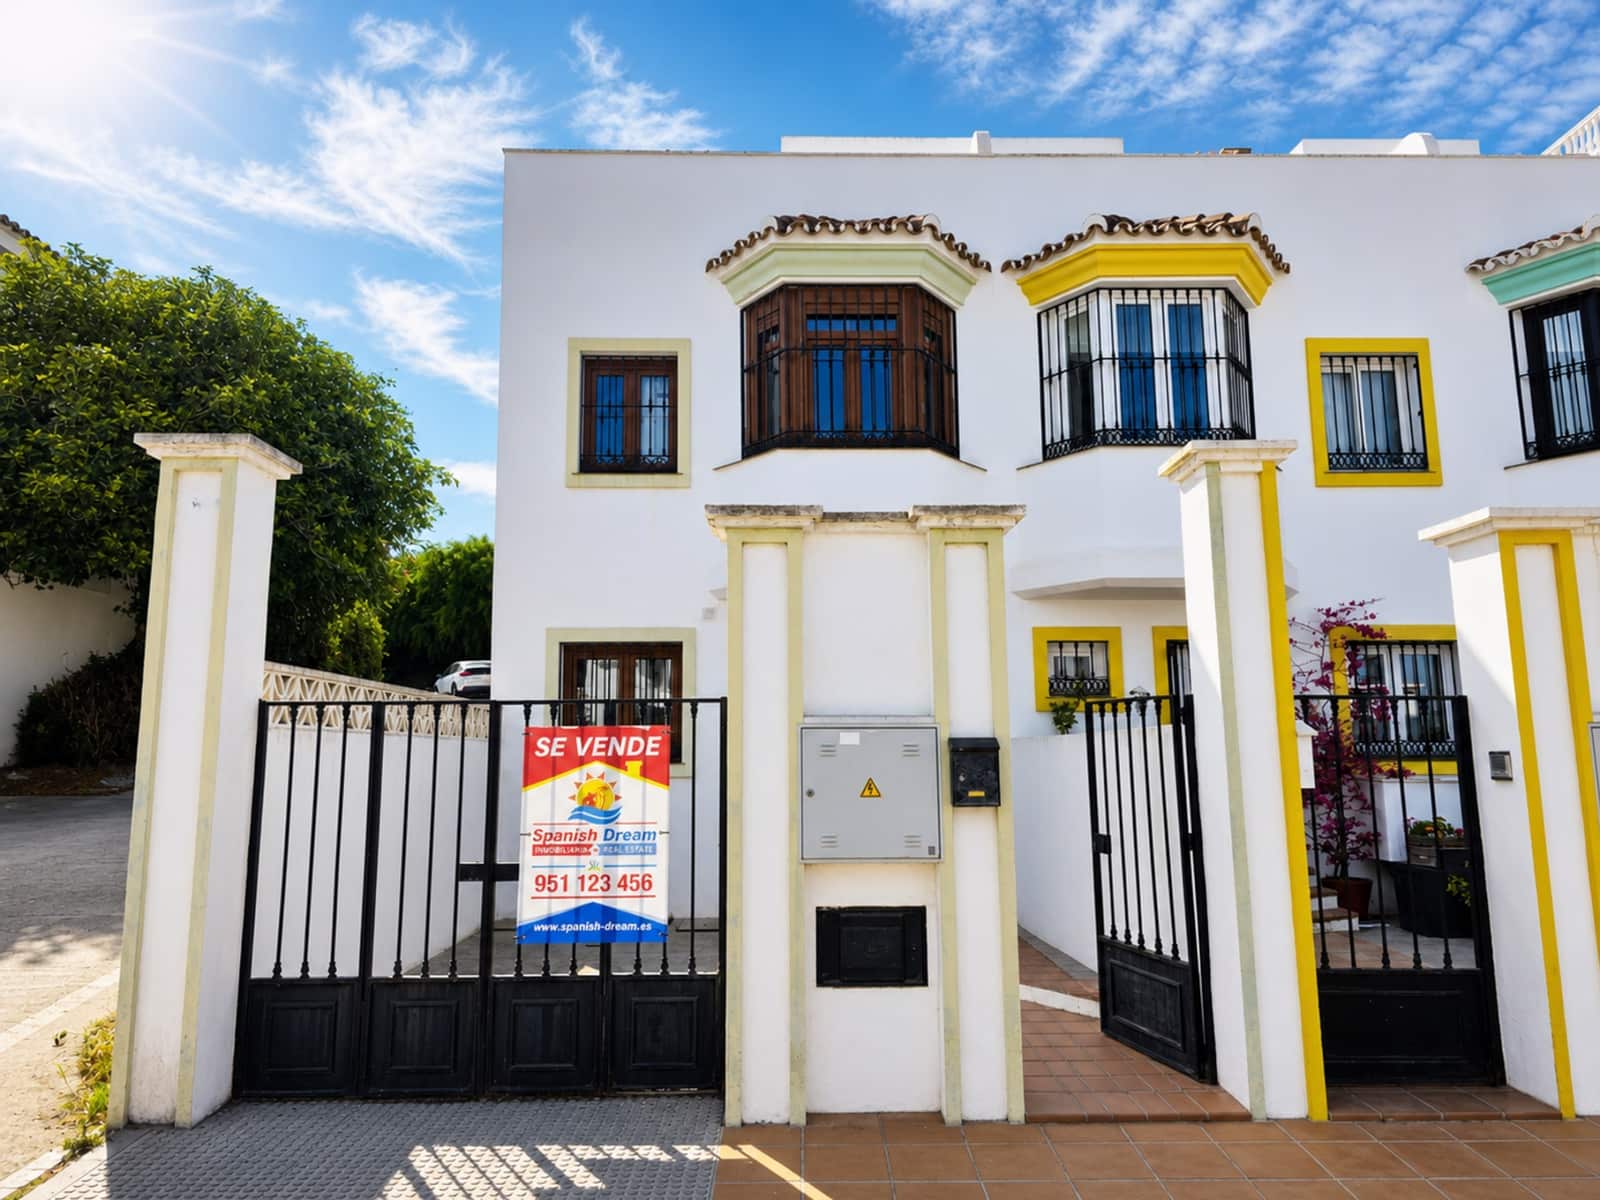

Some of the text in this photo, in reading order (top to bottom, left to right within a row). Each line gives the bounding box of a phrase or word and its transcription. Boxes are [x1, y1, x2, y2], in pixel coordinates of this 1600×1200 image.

[534, 735, 663, 757] SE VENDE
[532, 828, 657, 845] Spanish Dream
[534, 873, 654, 892] 951 123 456
[533, 921, 653, 933] www.spanish-dream.es
